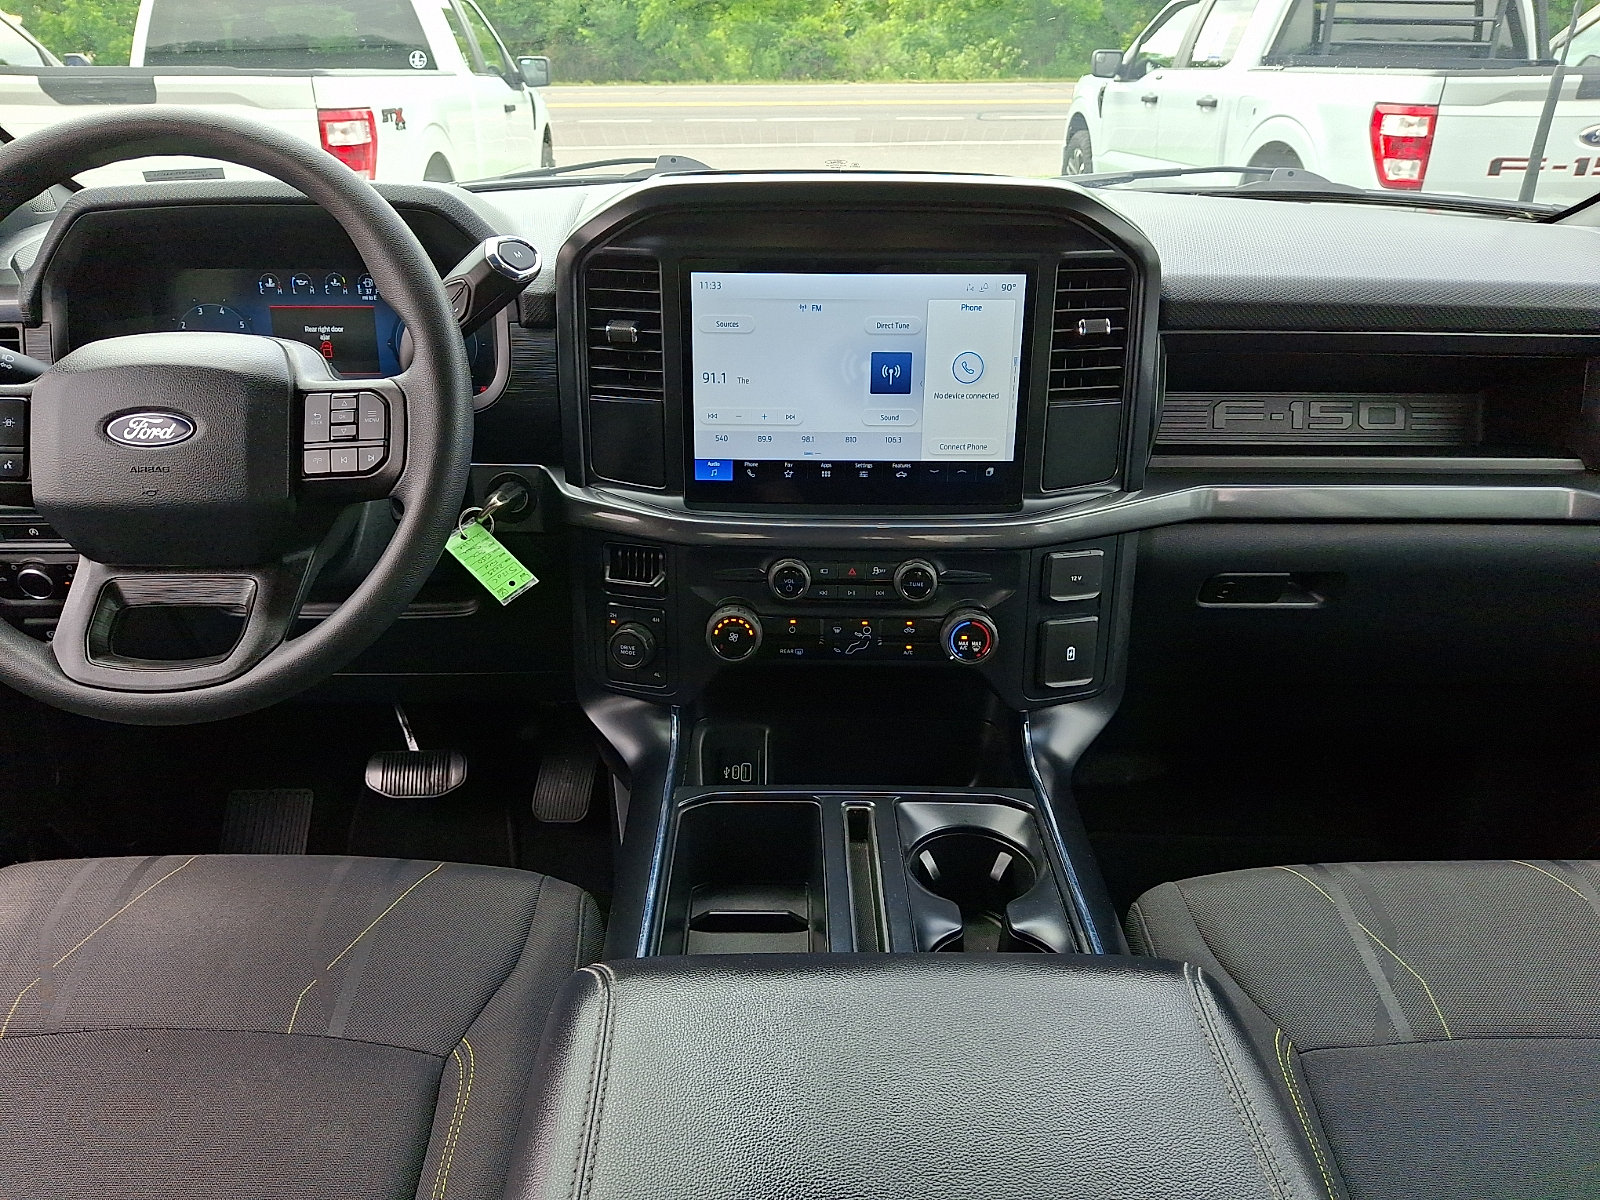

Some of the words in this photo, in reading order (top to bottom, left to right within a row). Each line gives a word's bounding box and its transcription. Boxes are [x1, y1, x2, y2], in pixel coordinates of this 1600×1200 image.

[698, 281, 722, 290] 11:33
[220, 307, 224, 315] 4
[811, 304, 822, 312] FM
[961, 304, 982, 312] Phone
[876, 321, 894, 330] Direct
[894, 321, 910, 330] Tune
[702, 372, 727, 384] 91.1
[737, 376, 750, 384] The
[934, 392, 944, 400] No
[945, 392, 965, 400] device
[965, 392, 999, 400] connected
[880, 413, 899, 422] Sound
[1212, 400, 1407, 430] F-150
[124, 417, 176, 440] Ford
[715, 434, 728, 442] 540
[757, 435, 772, 443] 89.9
